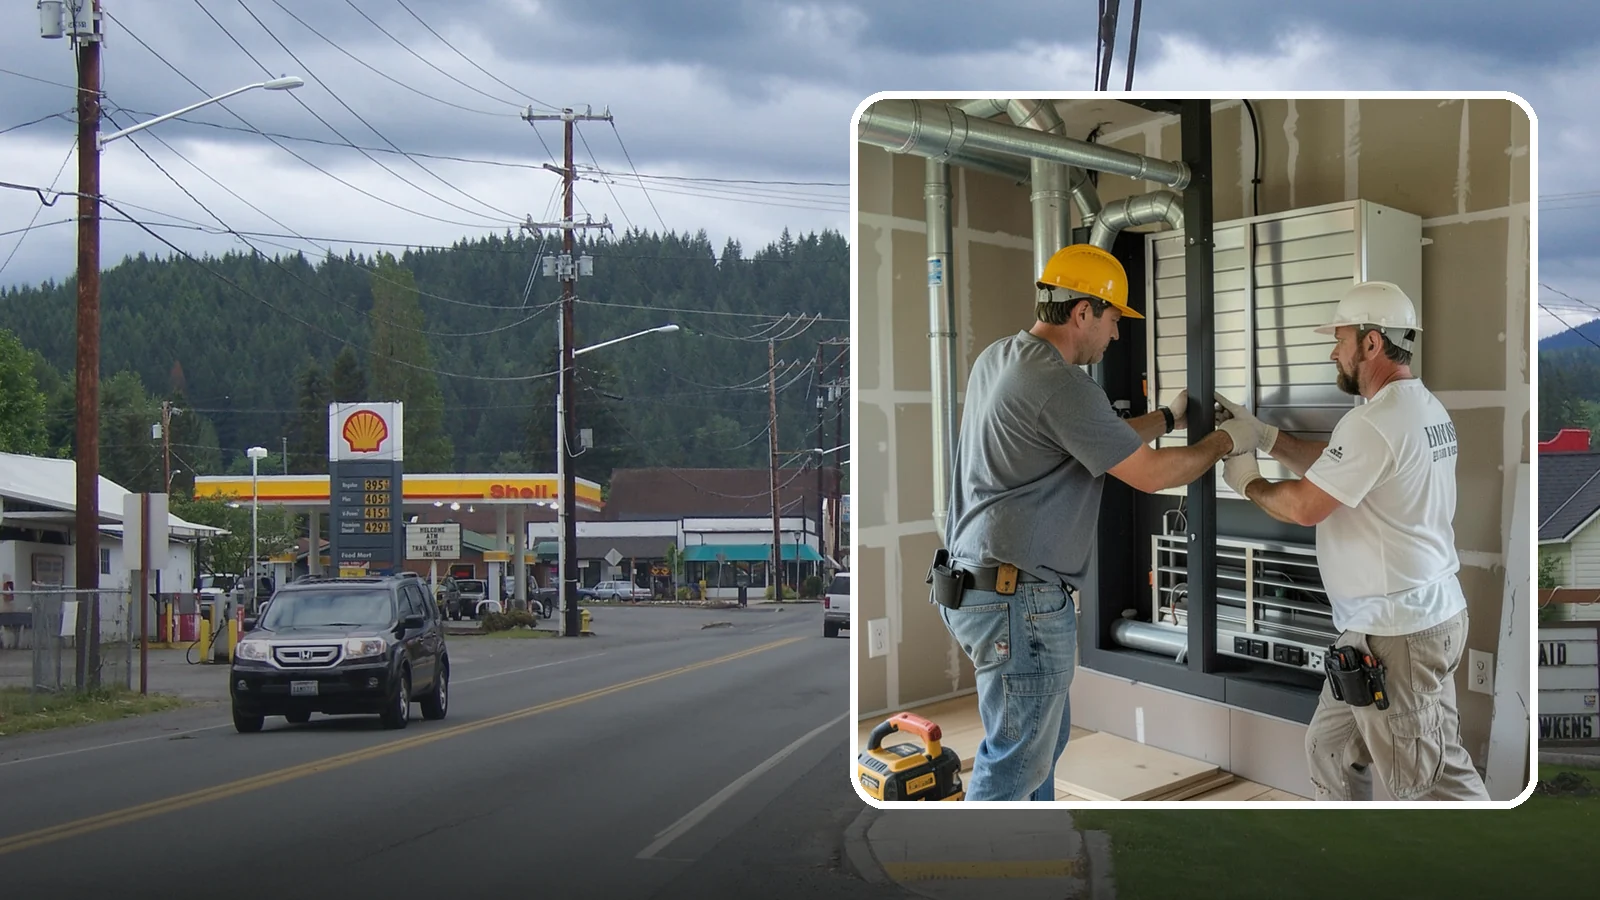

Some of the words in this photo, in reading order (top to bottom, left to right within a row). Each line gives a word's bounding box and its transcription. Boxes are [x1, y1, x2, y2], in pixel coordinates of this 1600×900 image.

[490, 484, 547, 499] Shell
[366, 494, 384, 504] 405
[366, 508, 384, 518] 415
[366, 522, 384, 532] 429
